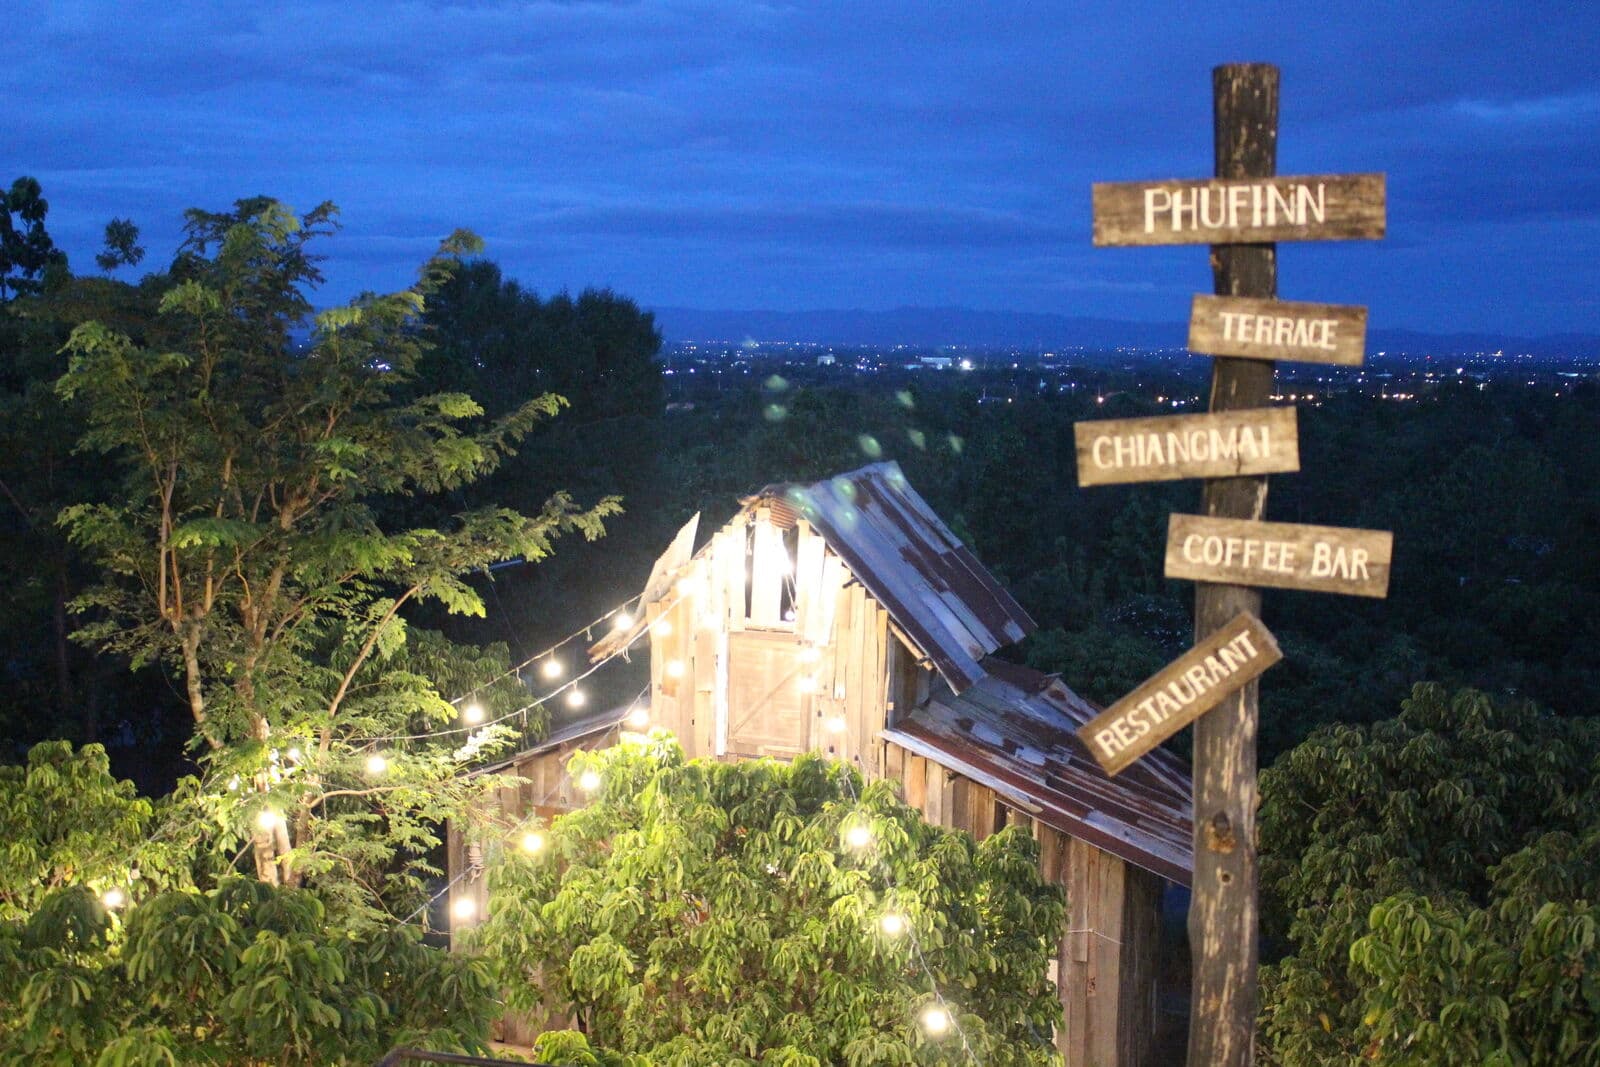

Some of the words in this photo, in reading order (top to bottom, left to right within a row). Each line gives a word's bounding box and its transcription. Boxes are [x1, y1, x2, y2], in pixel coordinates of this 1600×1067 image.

[1219, 312, 1339, 350] TERRACE
[1092, 426, 1271, 469] CHIANGMAI
[1183, 534, 1298, 573] COFFEE
[1311, 542, 1369, 580] BAR
[1094, 630, 1258, 758] RESTAURANT
